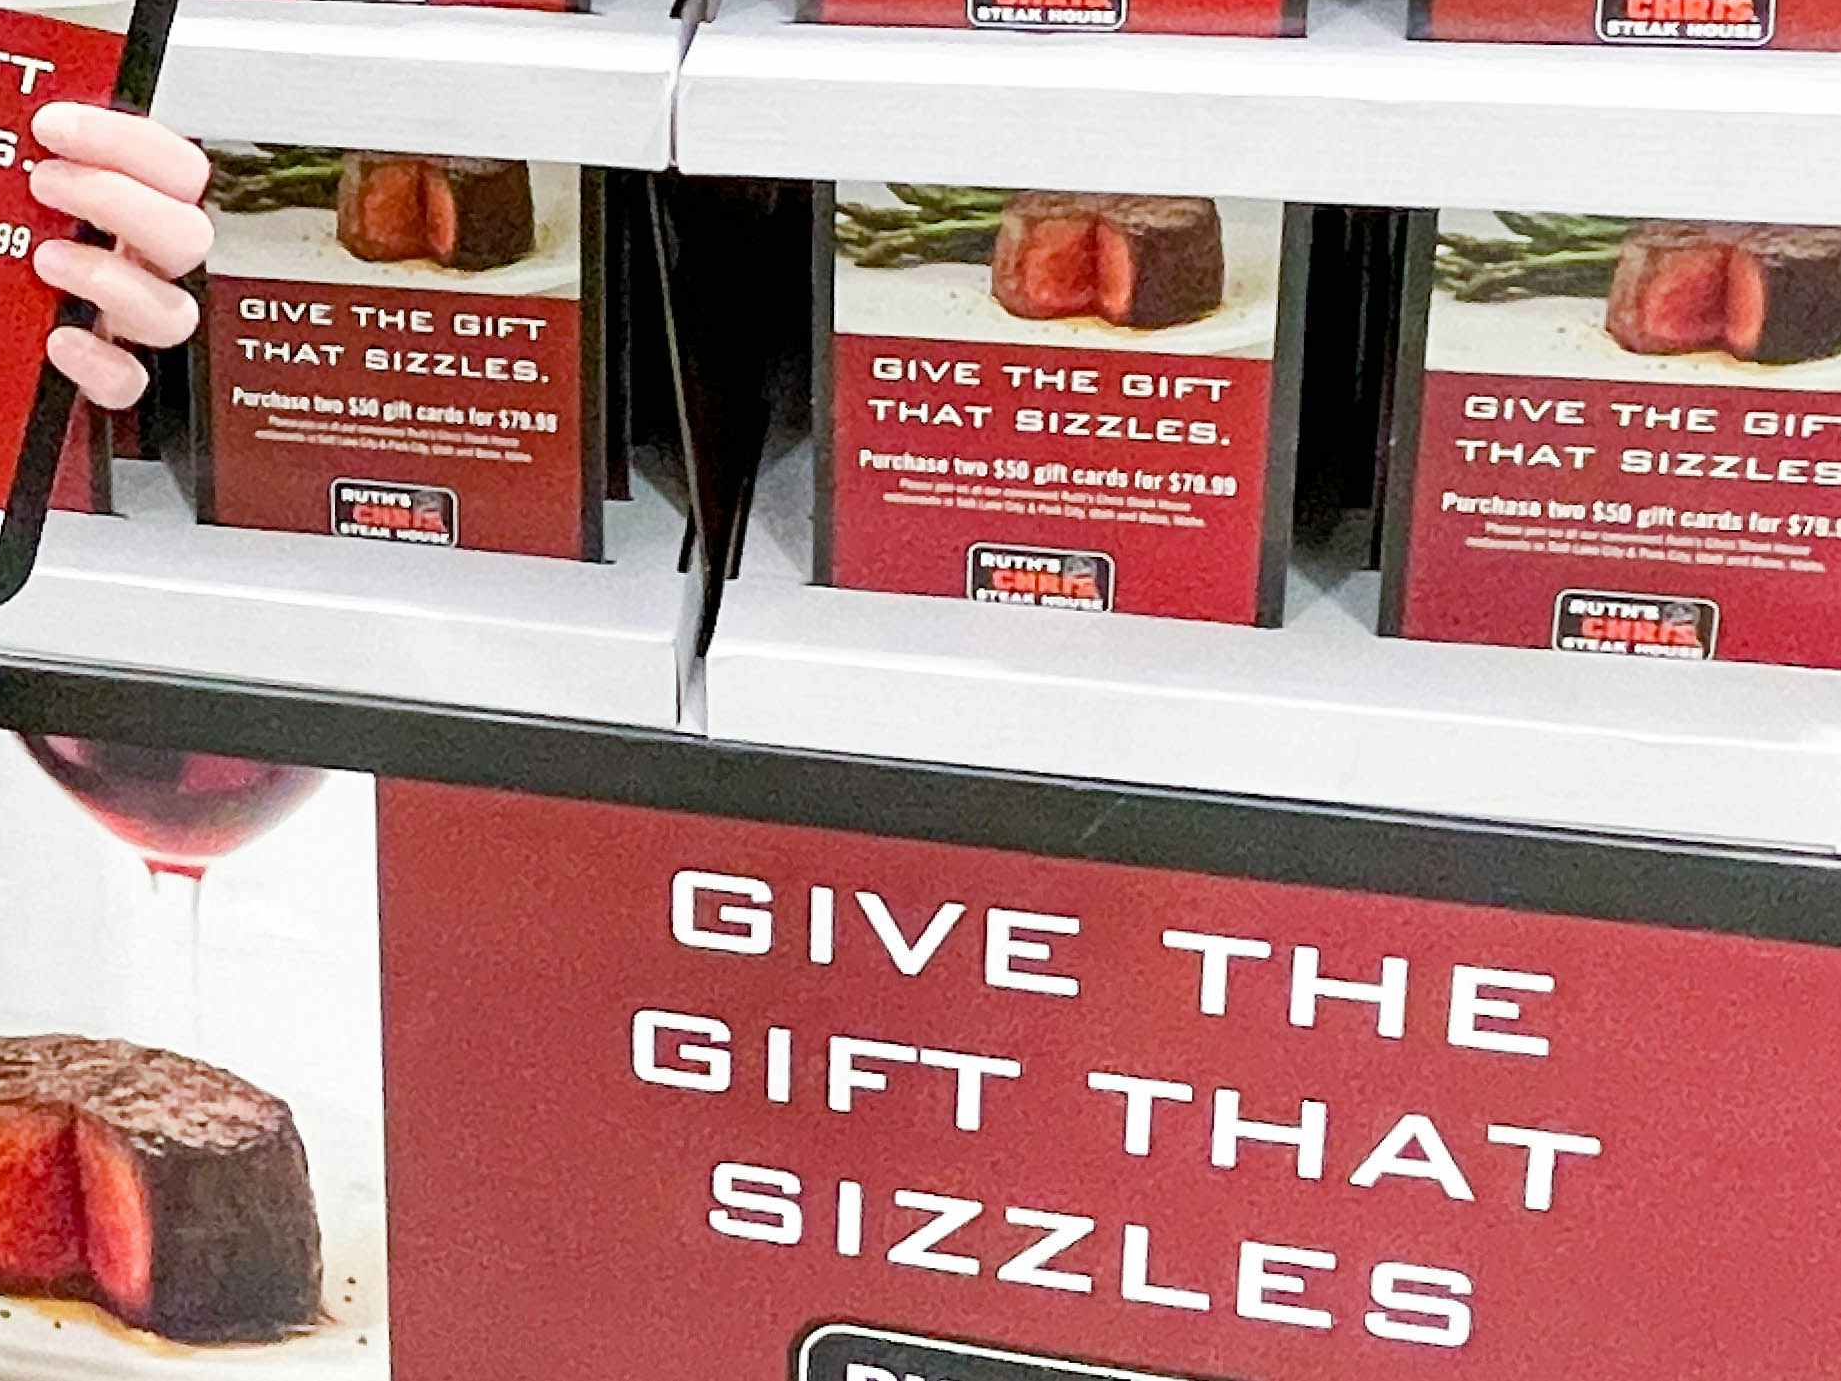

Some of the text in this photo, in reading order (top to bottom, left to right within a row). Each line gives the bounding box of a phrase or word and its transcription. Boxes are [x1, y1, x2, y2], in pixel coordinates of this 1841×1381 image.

[238, 297, 547, 341] GIVE THE GIFT
[236, 338, 550, 384] THAT SIZZLES.
[872, 356, 1231, 403] GIVE THE GIFT
[867, 399, 1231, 446] THAT SIZZLES.
[1463, 394, 1718, 433] GIVE THE
[1455, 439, 1596, 469] THAT
[669, 867, 1556, 1058] GIVE THE
[629, 1006, 1603, 1213] GIFT THAT
[706, 1159, 1475, 1351] SIZZLES
